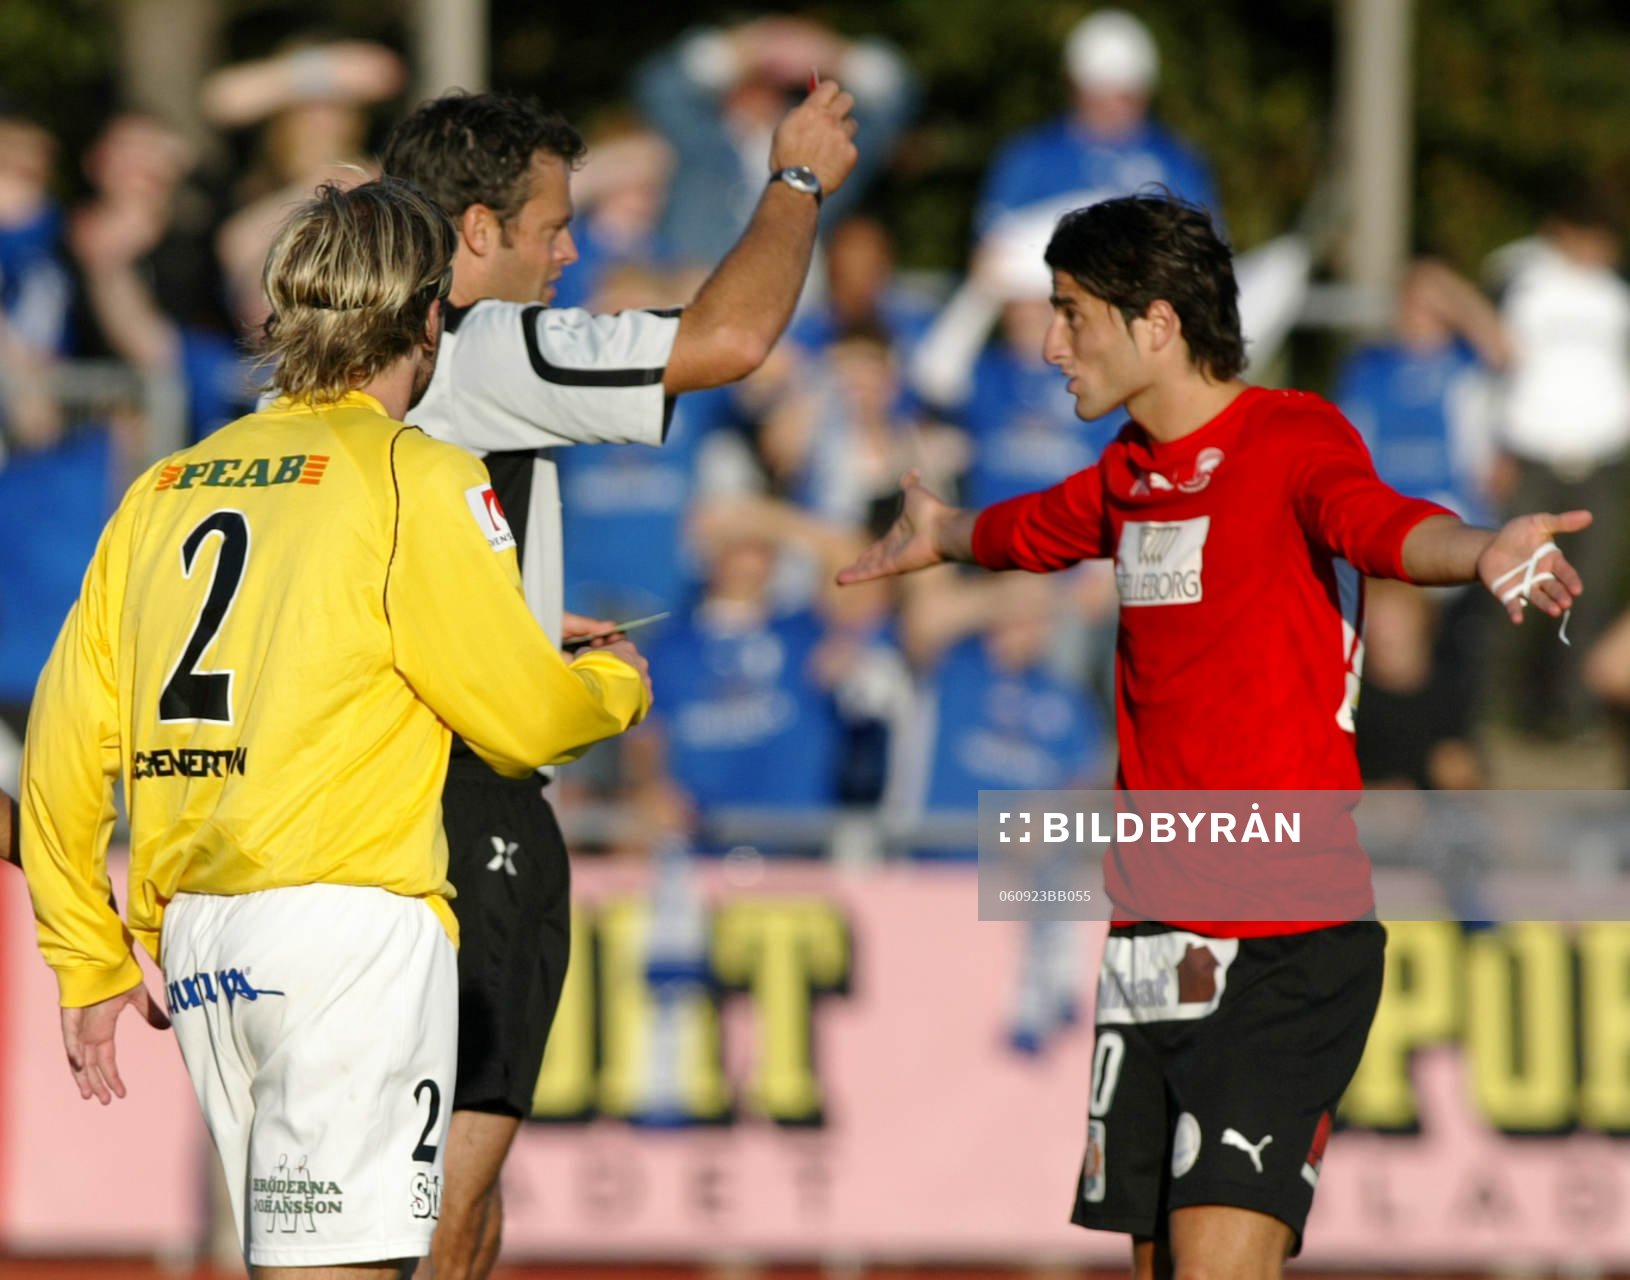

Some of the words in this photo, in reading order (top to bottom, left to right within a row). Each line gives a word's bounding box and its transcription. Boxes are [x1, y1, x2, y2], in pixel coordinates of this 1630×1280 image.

[172, 454, 307, 490] PEAB
[159, 508, 250, 726] 2
[411, 1078, 441, 1164] 2
